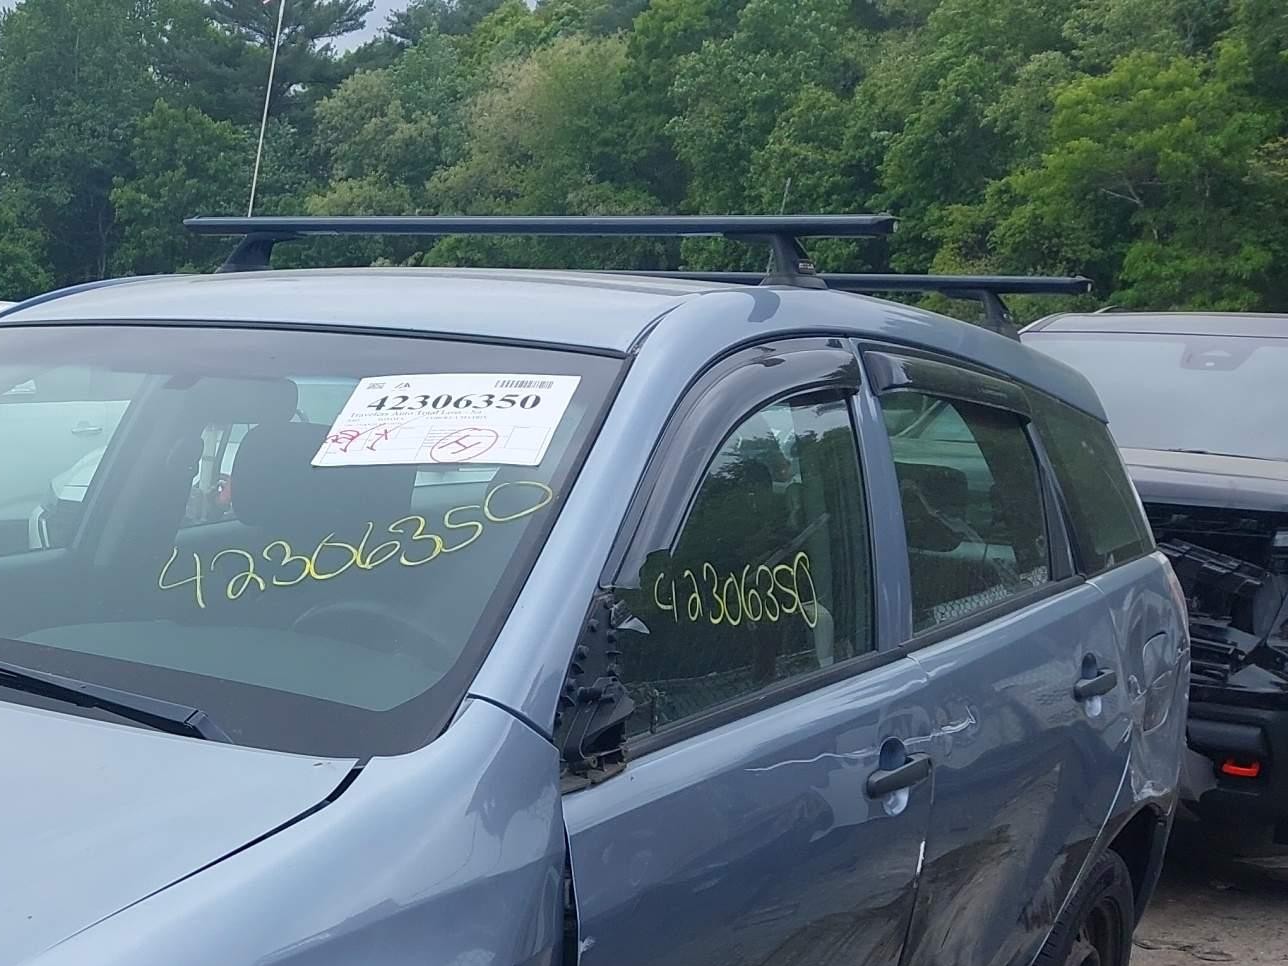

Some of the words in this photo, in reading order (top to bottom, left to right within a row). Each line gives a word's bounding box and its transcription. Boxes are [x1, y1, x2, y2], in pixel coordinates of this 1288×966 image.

[367, 393, 541, 411] 42306350
[159, 481, 553, 608] 42306350
[654, 551, 818, 628] 42306350
